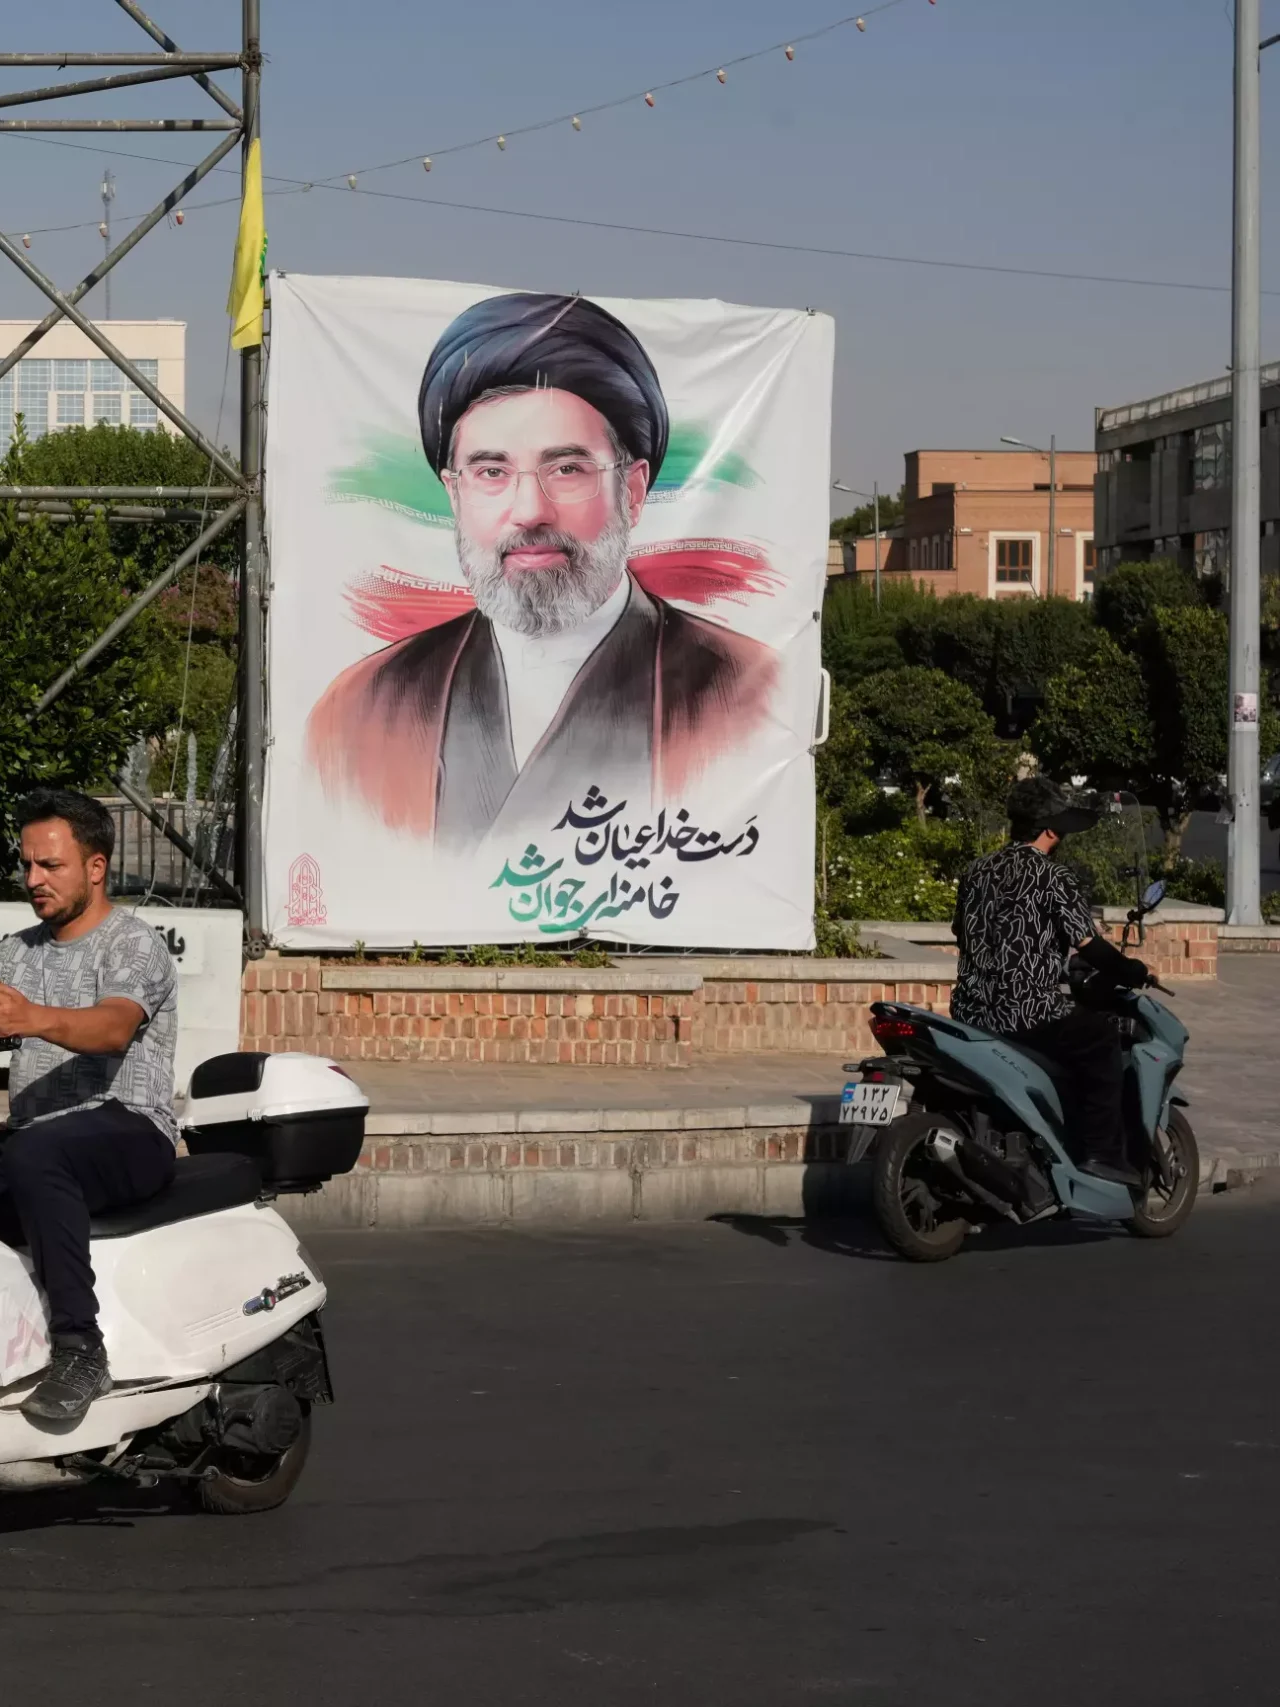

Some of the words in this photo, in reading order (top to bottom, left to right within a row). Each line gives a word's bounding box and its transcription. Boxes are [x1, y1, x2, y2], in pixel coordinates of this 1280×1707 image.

[551, 784, 628, 831] شد
[575, 820, 656, 870] عیان
[650, 808, 699, 855] خدا
[487, 843, 565, 889] شد
[508, 878, 586, 922] جوان
[862, 1086, 890, 1102] ۱۳۲
